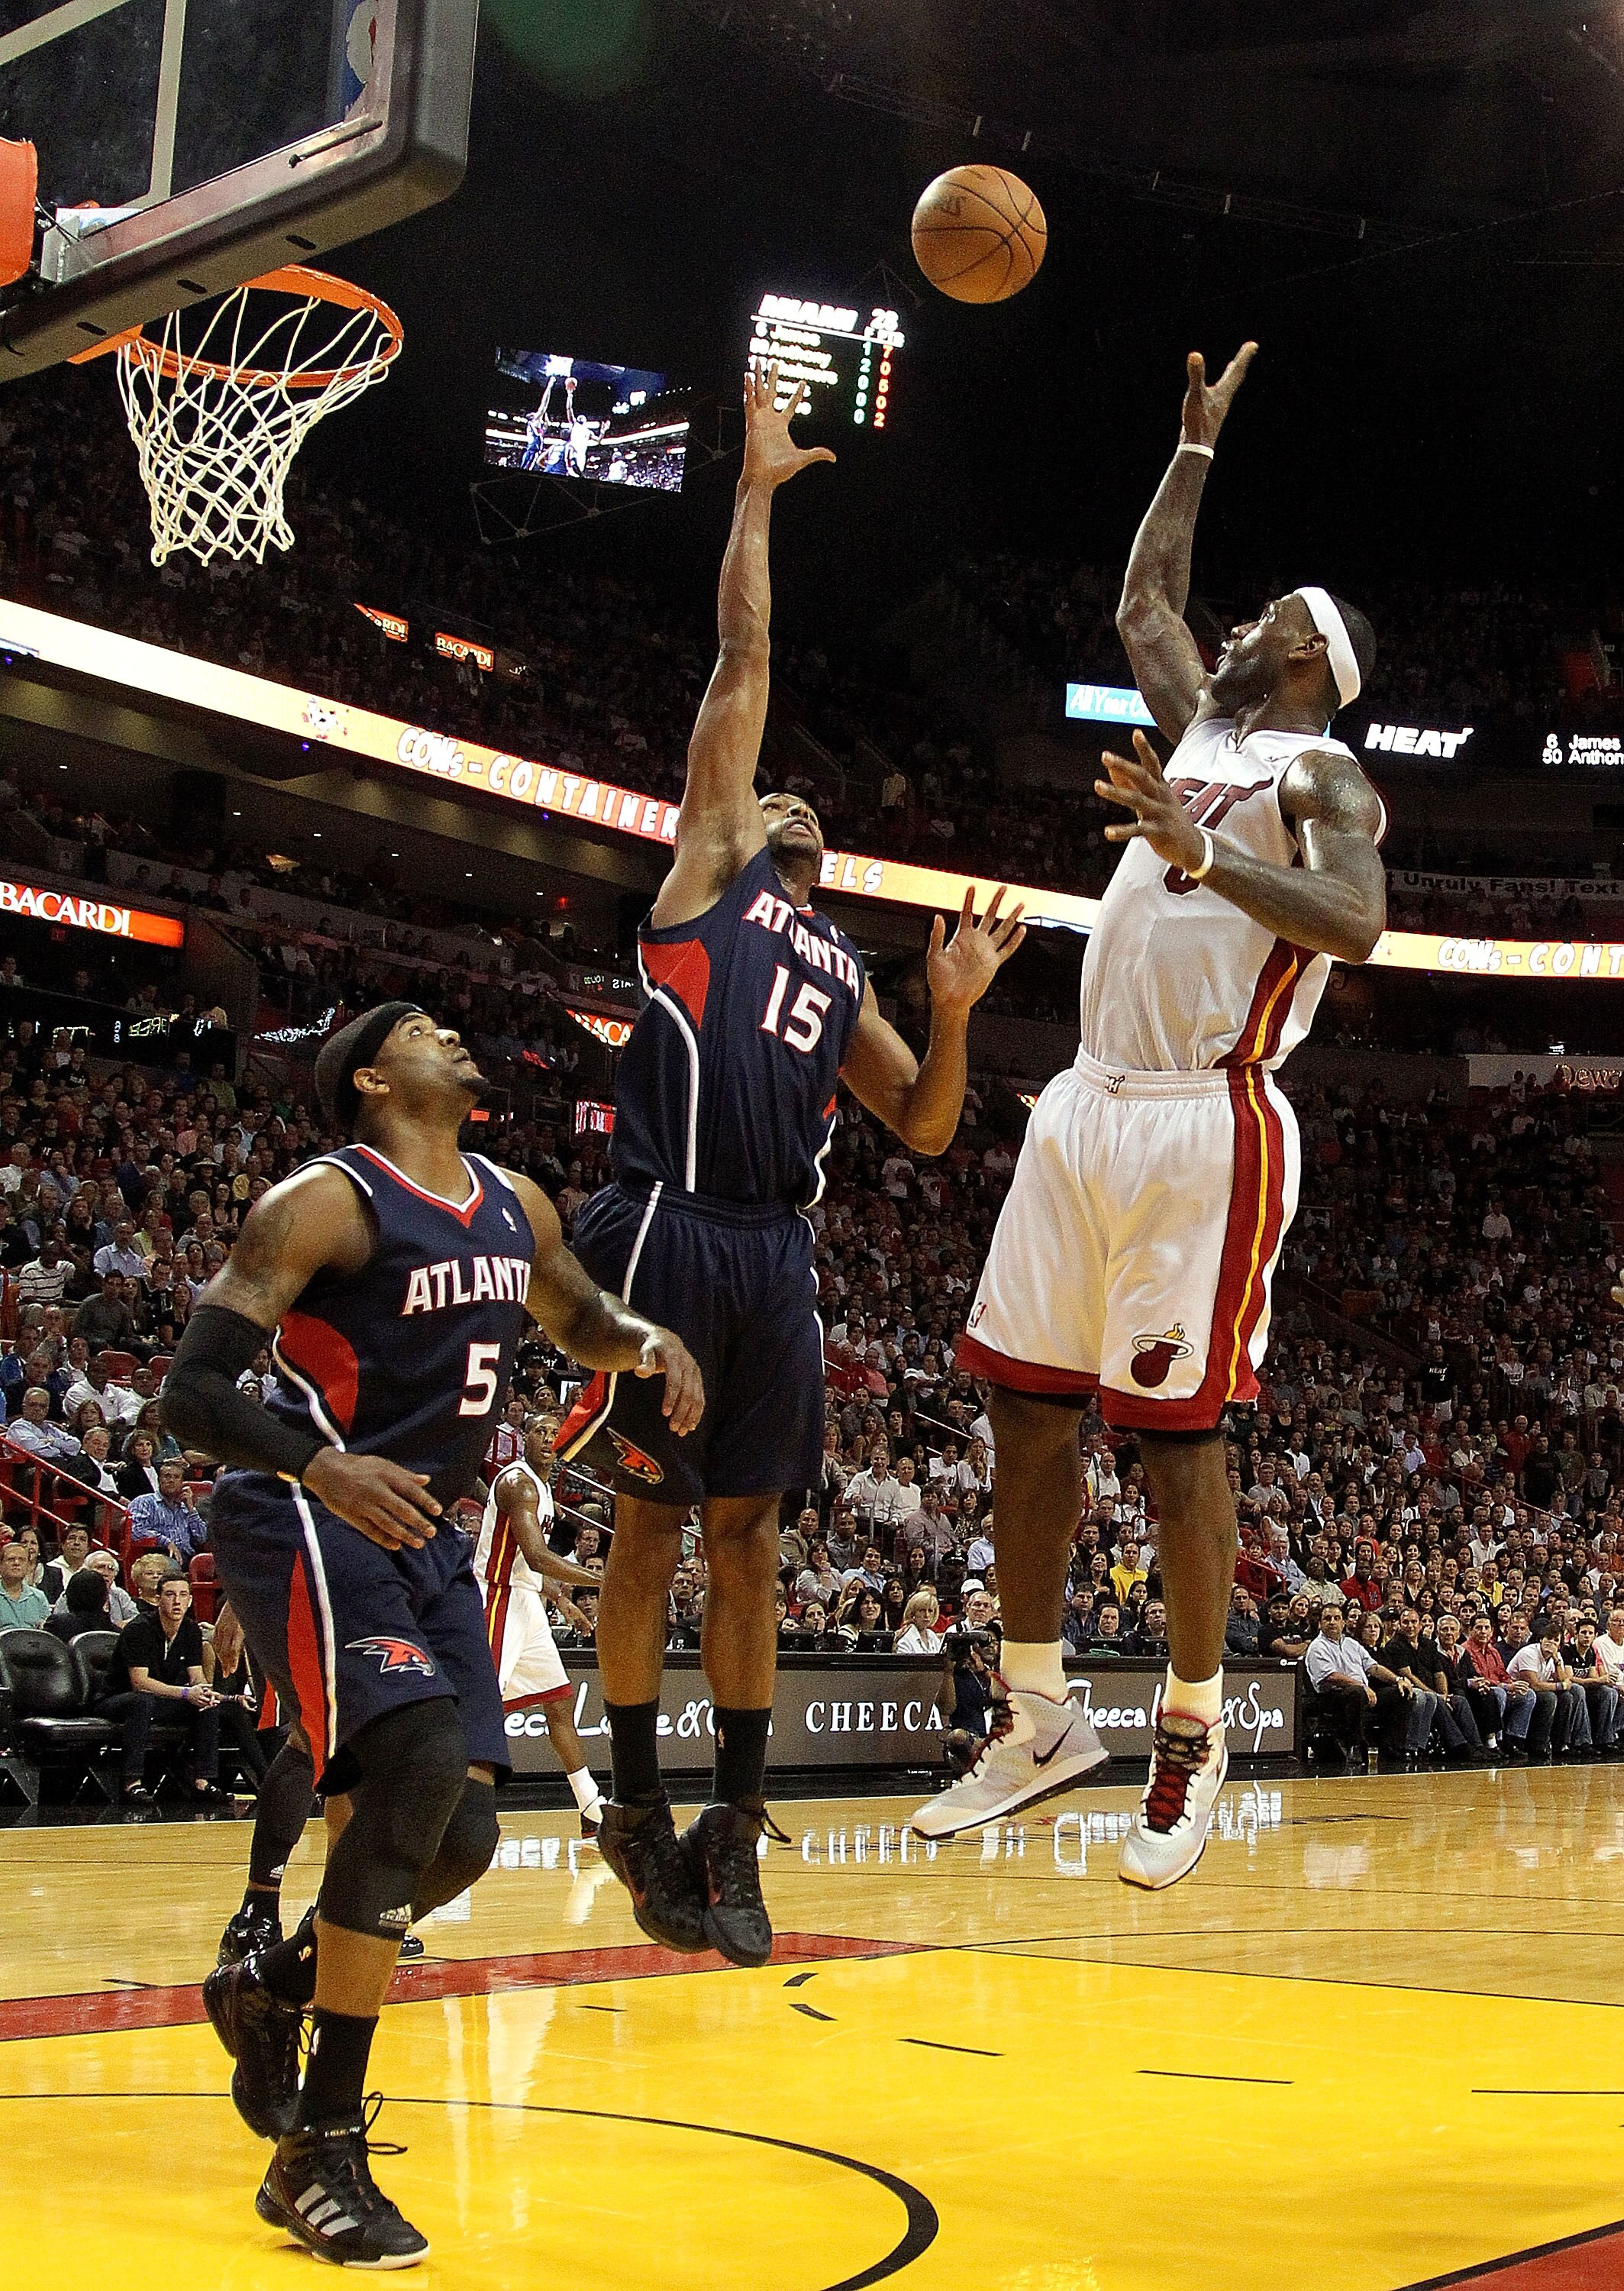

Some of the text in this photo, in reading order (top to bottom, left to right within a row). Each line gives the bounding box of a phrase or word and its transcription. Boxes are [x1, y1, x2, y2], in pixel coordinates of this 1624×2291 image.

[860, 358, 872, 373] 2
[880, 360, 892, 375] 0
[857, 374, 870, 390] 0
[856, 392, 887, 410] 0 0
[854, 408, 885, 428] 0 2
[1364, 723, 1474, 758] HEAT
[1546, 732, 1621, 751] 6 James
[1542, 748, 1563, 764] 50
[1168, 776, 1274, 831] EAT
[1565, 879, 1619, 895] Text
[759, 963, 832, 1053] 15
[458, 1341, 501, 1417] 5
[805, 1701, 944, 1734] CHEECA
